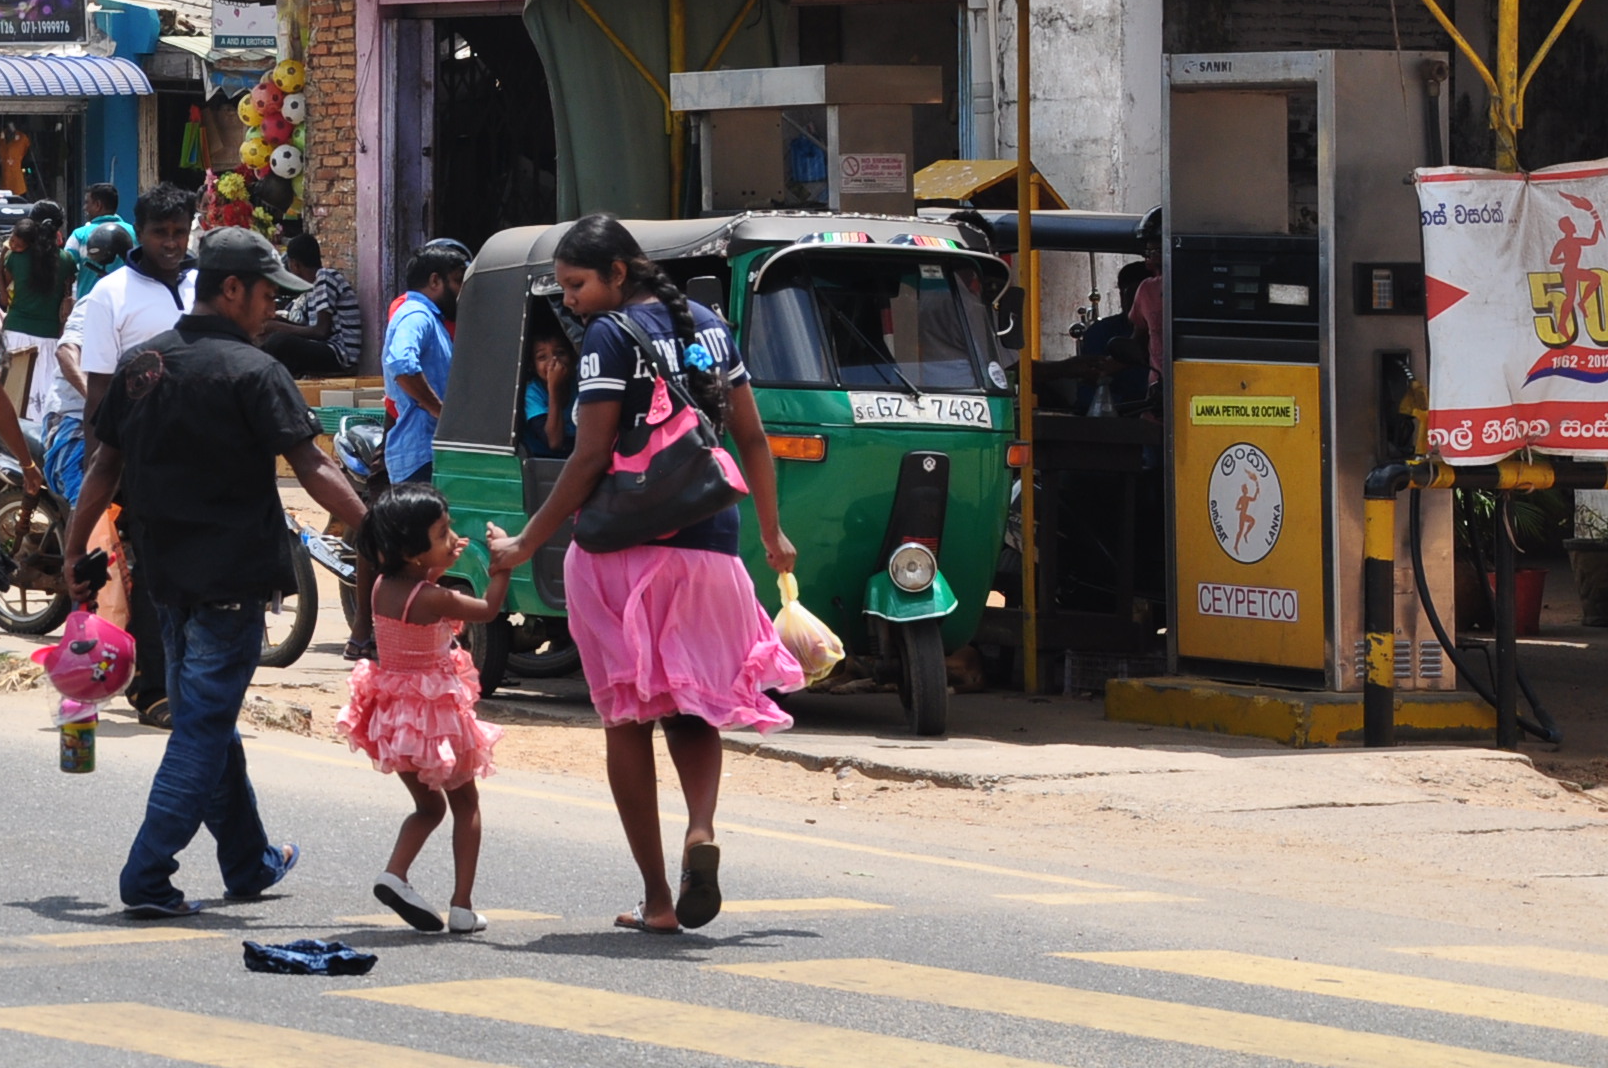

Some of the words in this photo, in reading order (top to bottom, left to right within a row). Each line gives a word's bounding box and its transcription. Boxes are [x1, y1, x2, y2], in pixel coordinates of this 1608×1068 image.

[1199, 60, 1232, 72] SANKI
[580, 352, 600, 378] 60
[876, 397, 908, 418] GZ
[931, 399, 988, 423] 7482
[1196, 404, 1221, 416] LANKA
[1222, 406, 1249, 417] PETROL
[1252, 406, 1260, 417] 92
[1262, 406, 1291, 418] OCTANE
[1221, 448, 1268, 478] ලංකා
[1265, 504, 1281, 546] LANKA
[1200, 585, 1296, 620] CEYPETCO
